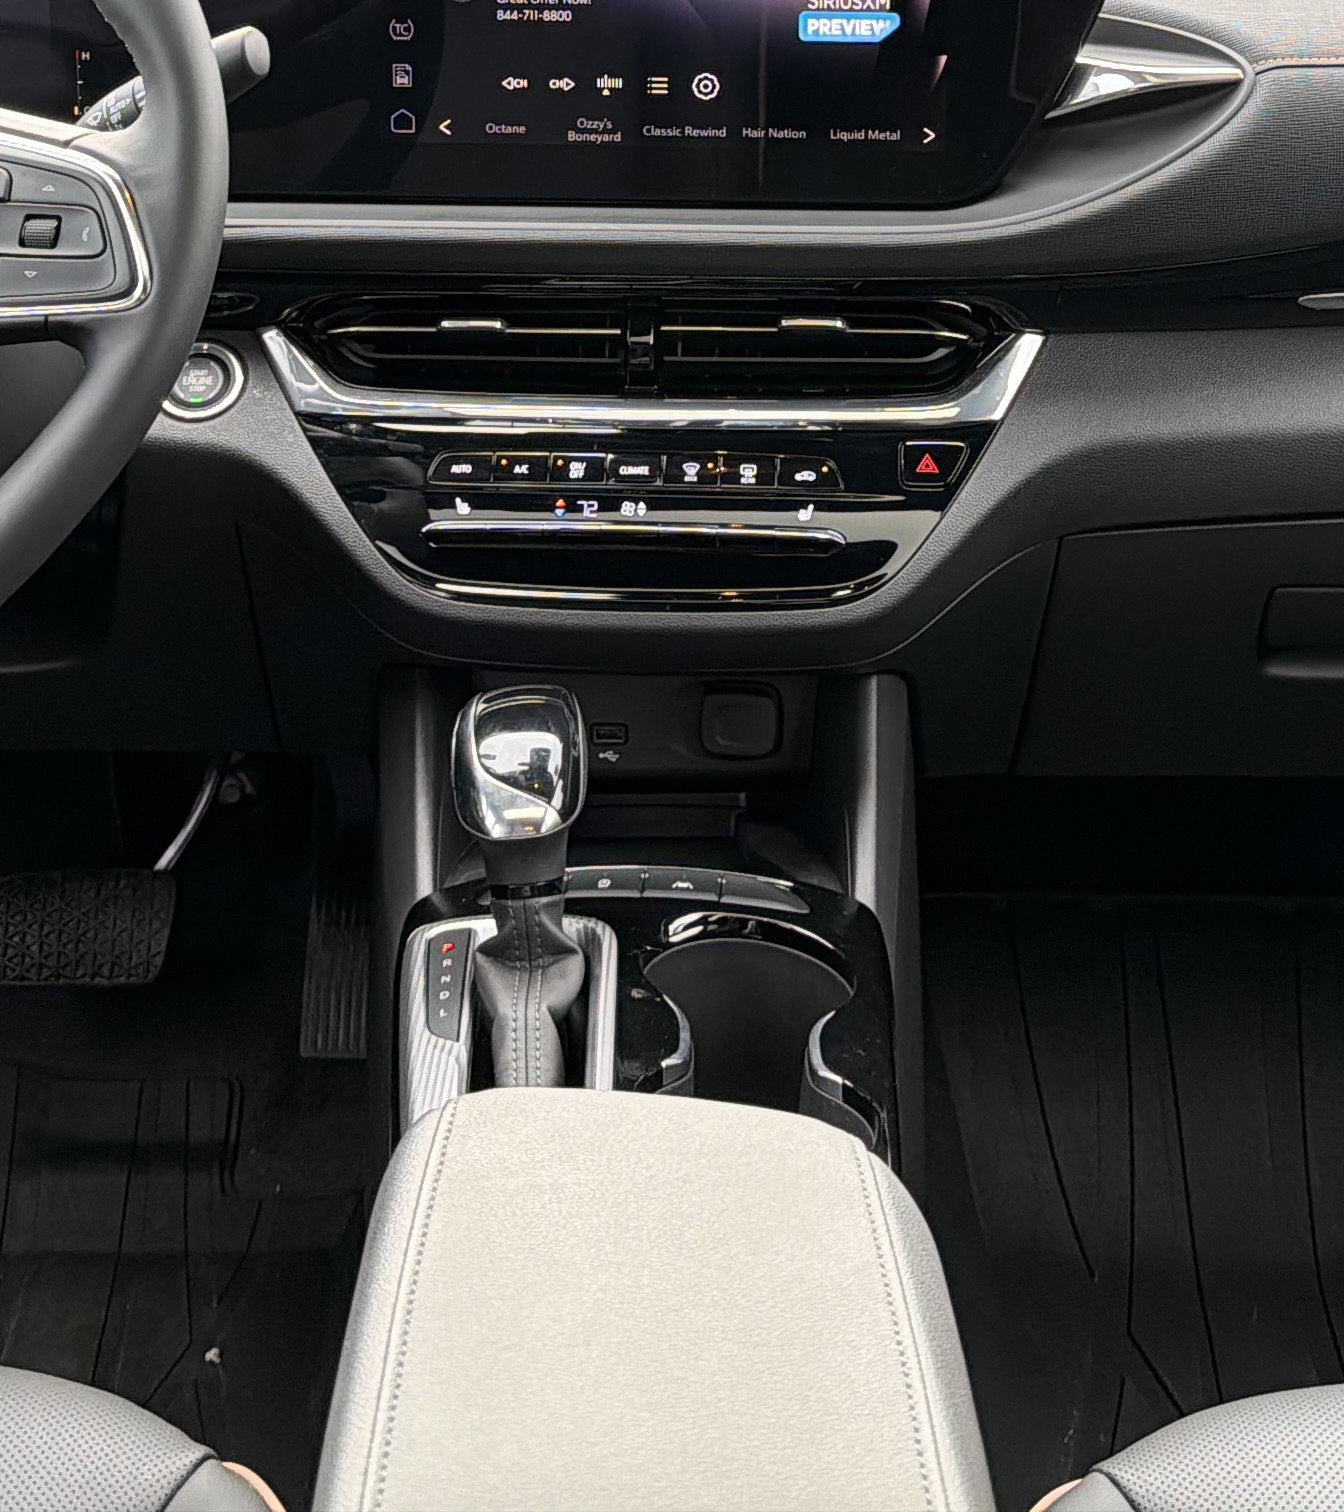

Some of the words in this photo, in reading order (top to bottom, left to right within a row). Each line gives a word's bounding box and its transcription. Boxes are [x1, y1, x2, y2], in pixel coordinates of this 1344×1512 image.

[496, 9, 572, 22] 844-711-8800
[394, 23, 409, 35] TC
[81, 51, 90, 61] H
[514, 79, 529, 88] CH
[549, 79, 564, 89] CH
[485, 122, 526, 134] Octane
[576, 118, 613, 131] Ozzy's
[642, 125, 682, 137] Classic
[685, 126, 727, 138] Rewind
[742, 127, 765, 138] Hair
[768, 127, 806, 139] Nation
[830, 128, 865, 143] Liquid
[868, 129, 901, 141] Metal
[567, 130, 622, 144] Boneyard
[182, 375, 214, 386] ENGINE
[450, 465, 472, 474] AUTO
[514, 465, 529, 474] A/C
[569, 461, 586, 471] ON/
[619, 466, 650, 475] CLIMATE
[569, 469, 584, 479] OFF
[576, 500, 599, 518] 72
[442, 943, 455, 954] P
[442, 958, 453, 968] R
[440, 974, 451, 984] N
[439, 990, 450, 1000] D
[439, 1008, 448, 1018] L
